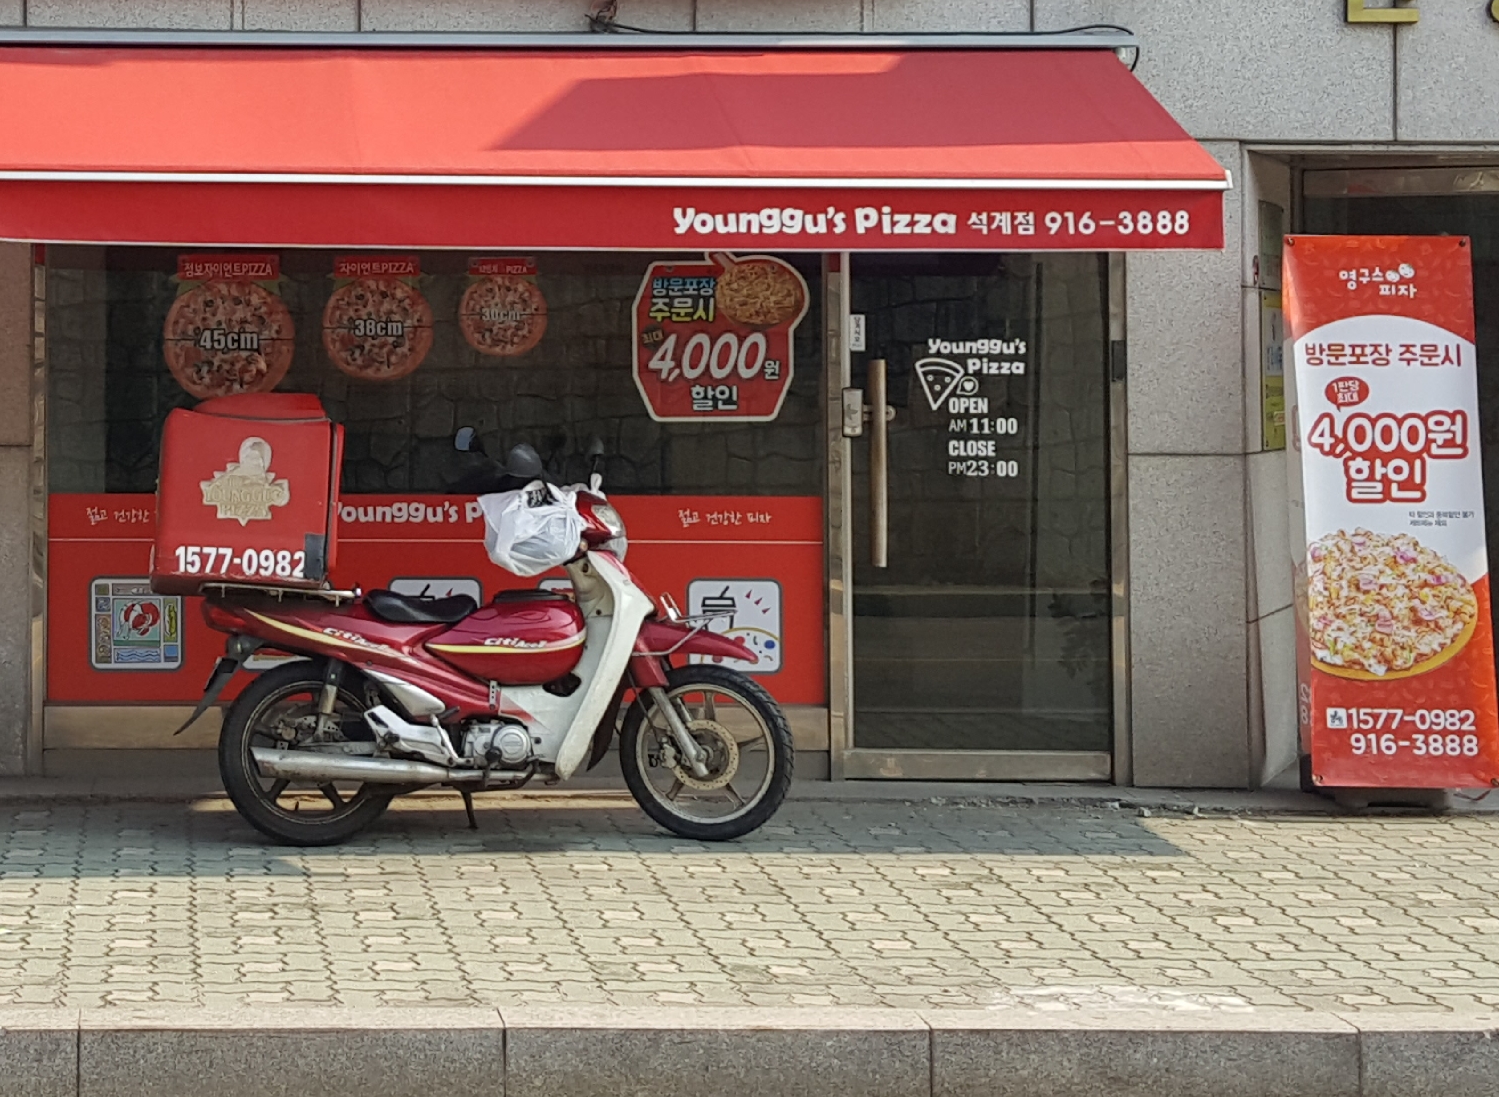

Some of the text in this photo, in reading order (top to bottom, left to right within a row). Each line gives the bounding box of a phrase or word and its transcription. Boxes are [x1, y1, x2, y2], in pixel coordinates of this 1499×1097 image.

[673, 206, 1191, 236] Younggu's Pizza 석계점 916-3888
[652, 276, 717, 297] 방문포장
[1338, 266, 1385, 290] 영구스
[1378, 283, 1418, 299] 피자
[482, 307, 521, 322] 30cm
[648, 297, 716, 322] 주문시
[352, 318, 404, 338] 38cm
[198, 328, 260, 352] 45cm
[927, 338, 1027, 355] Younggu's
[1305, 342, 1393, 367] 방문포장
[1398, 343, 1463, 368] 주문시
[966, 357, 1026, 375] Pizza
[690, 384, 739, 412] 할인
[948, 397, 990, 414] OPEN
[1336, 391, 1360, 404] 최대
[948, 417, 1019, 435] AM 11:00
[1309, 411, 1467, 458] 4,000원
[948, 440, 997, 457] CLOSE
[948, 460, 1019, 477] PM 23:00
[1347, 457, 1424, 501] 할인
[113, 507, 151, 524] 건강한
[705, 509, 743, 526] 건강한
[747, 510, 773, 525] 피자
[175, 545, 306, 579] 1577-0982
[1347, 708, 1476, 731] 1577-0982
[1350, 733, 1479, 757] 916-3888
